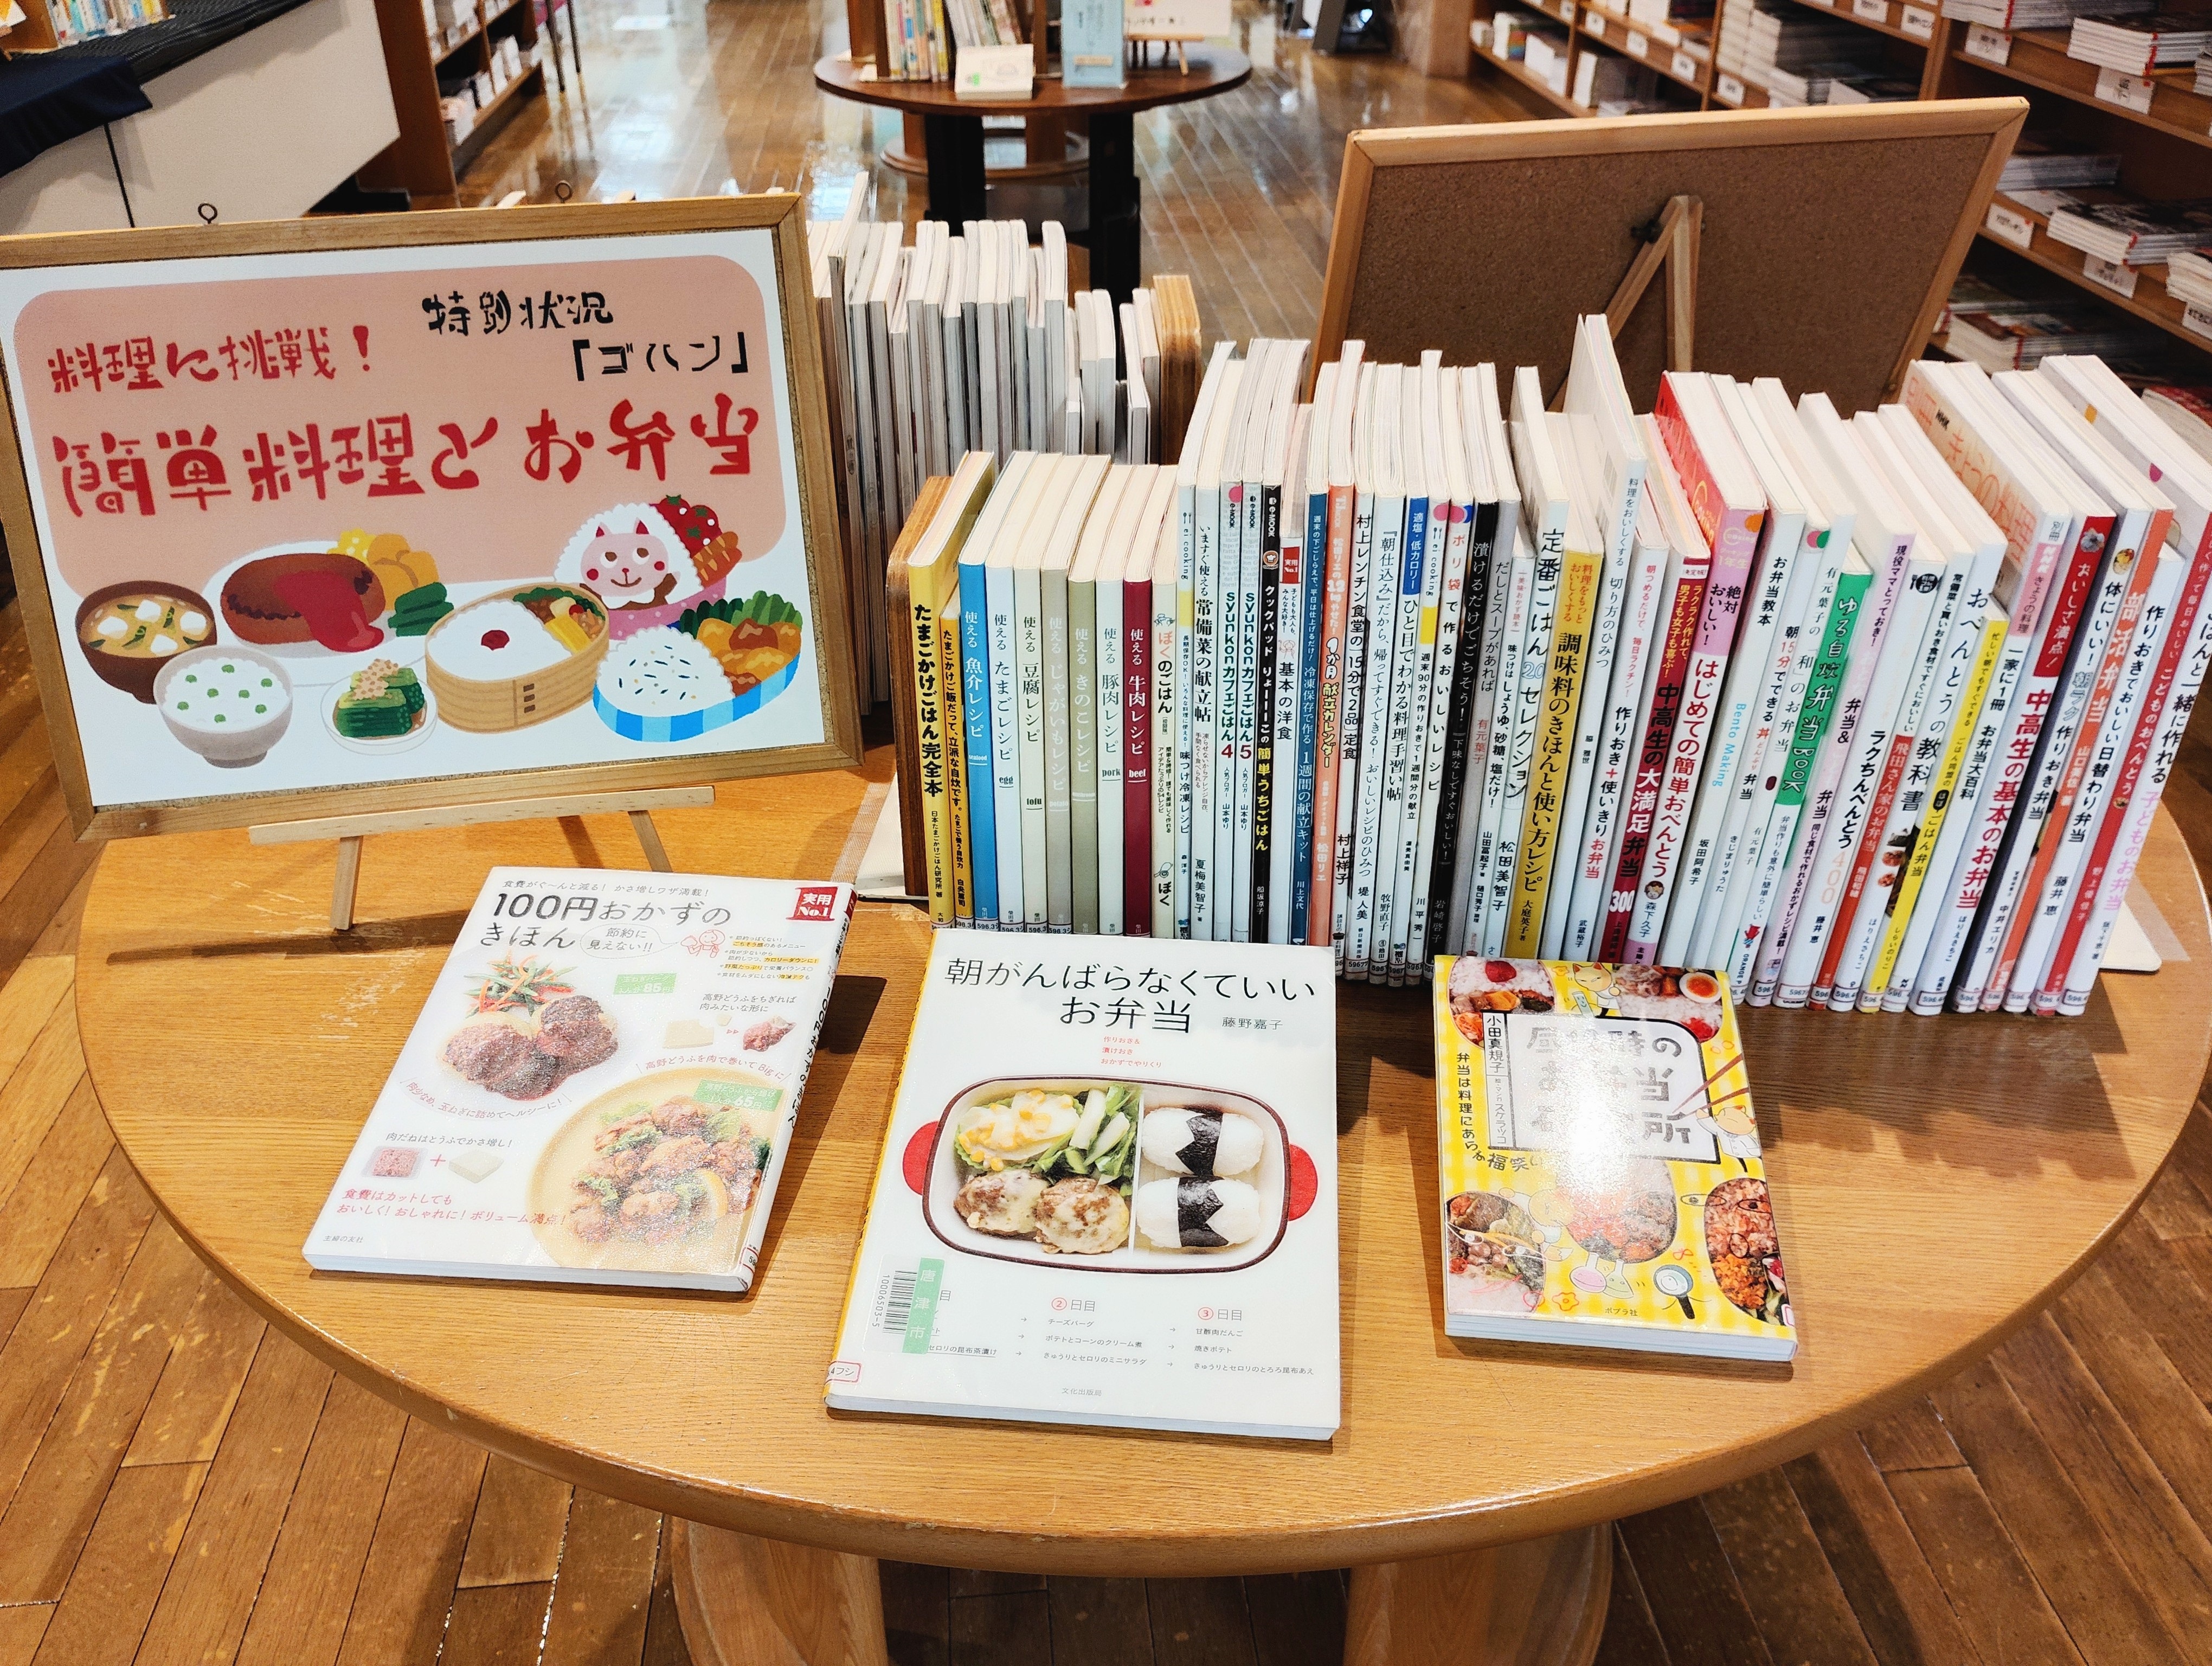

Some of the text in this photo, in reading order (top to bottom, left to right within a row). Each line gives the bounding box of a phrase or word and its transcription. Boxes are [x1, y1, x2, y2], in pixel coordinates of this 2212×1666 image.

[422, 290, 614, 335] 特別状況
[573, 332, 749, 383] 「ゴハン」
[53, 393, 759, 516] 簡単料理とお弁当
[1181, 541, 1192, 580] cooking
[1284, 558, 1298, 566] 実用
[1596, 478, 1639, 668] 料理をおいしくする 切り方のひみつ
[1563, 563, 1580, 622] おいしくする
[1576, 564, 1593, 624] 料理をもっと
[1703, 584, 1726, 645] おいしい！
[1722, 586, 1742, 614] 絶対
[1757, 556, 1787, 626] お弁当教本
[1263, 585, 1275, 657] クックパッド
[1459, 542, 1490, 722] 漬けるだけでごちそう！
[1481, 561, 1510, 692] だしとスープがあれば
[965, 611, 984, 738] 使える 魚介レシピ
[994, 613, 1013, 760] 使える たまごレシピ
[1023, 616, 1040, 742] 使える 豆腐レシピ
[1158, 630, 1173, 714] ぼくのごはん
[1194, 598, 1213, 723] 常備菜の献立帖
[1428, 534, 1466, 791] ポリ袋で作るおいしいレシピ
[914, 604, 943, 797] たまごかけごはん完全本
[1049, 618, 1066, 791] 使える じゃがいもレシピ
[1074, 627, 1091, 773] 使える きのこレシピ
[1102, 627, 1120, 753] 使える 豚肉レシピ
[1128, 628, 1146, 755] 使える 牛肉レシピ
[1276, 662, 1295, 740] 基本の洋食
[1301, 666, 1317, 745] 冷凍保存で作る
[1386, 599, 1418, 802] ひと目でわかる料理手習い帖
[1901, 588, 1989, 812] おべんとうの教科書
[2028, 582, 2123, 821] 体にいい！ 作りおき弁当
[943, 630, 962, 811] たまごかけご飯だって、立派な自炊です。
[1473, 719, 1489, 765] 有元葉子
[1712, 703, 1747, 787] Bento Making
[2068, 605, 2166, 843] 作りおきでおいしい日替わり弁当
[999, 776, 1014, 786] egg
[1102, 768, 1121, 777] pork
[1523, 632, 1583, 892] 調味料のきほんと使い方レシピ
[1652, 659, 1719, 878] はじめての簡単おべんとう
[1026, 797, 1042, 805] tofu
[1180, 751, 1191, 835] 味つけ冷凍レシピ
[1838, 731, 1886, 849] ラクちんべんとう
[1956, 689, 2054, 910] 中高生の基本のお弁当
[1240, 804, 1249, 831] 山本ゆり
[1359, 764, 1378, 877] おいしいレシピのひみつ
[1335, 834, 1352, 885] 村上祥子
[1689, 838, 1709, 885] 坂田阿希子
[1715, 835, 1738, 893] きじまりゅうた
[1745, 827, 1763, 866] 有元葉子
[801, 893, 832, 906] 実用
[1158, 881, 1172, 907] ぼく
[1296, 880, 1306, 910] 川上文代
[1491, 841, 1516, 912] 松田美智子
[480, 924, 576, 949] きほん
[493, 893, 731, 926] 100円おかずの
[605, 926, 647, 939] 節約に
[798, 905, 831, 917] No.1
[1378, 893, 1391, 932] 牧野直子
[1413, 898, 1425, 940] 川平秀一
[1639, 901, 1657, 938] 森下久子
[702, 993, 798, 1004] 高野どうふをちぎれば
[944, 958, 1316, 1002] 朝がんばらなくていい
[699, 1002, 769, 1013] 肉みたいな形に
[1059, 996, 1192, 1034] お弁当
[1220, 1016, 1284, 1033] 藤野嘉子
[1101, 1057, 1162, 1069] おかずでやりくり
[1102, 1046, 1134, 1056] 漬けおき
[1487, 1015, 1505, 1074] 小田真規子
[342, 1188, 452, 1206] 食費はカットしても
[871, 1274, 891, 1328] 10006503-5
[909, 1268, 937, 1340] 唐津市
[1047, 1317, 1095, 1328] チーズバーグ
[1604, 1306, 1638, 1318] ポプラ社
[1043, 1351, 1148, 1367] きゅうりとセロリのミニサラダ
[1045, 1334, 1143, 1349] ポテトとコーンのクリーム煮
[1194, 1344, 1233, 1354] 焼きポテト
[1061, 1386, 1103, 1398] 文化出版局
[1193, 1362, 1315, 1377] きゅうりとセロリのとろろ昆布あえ
